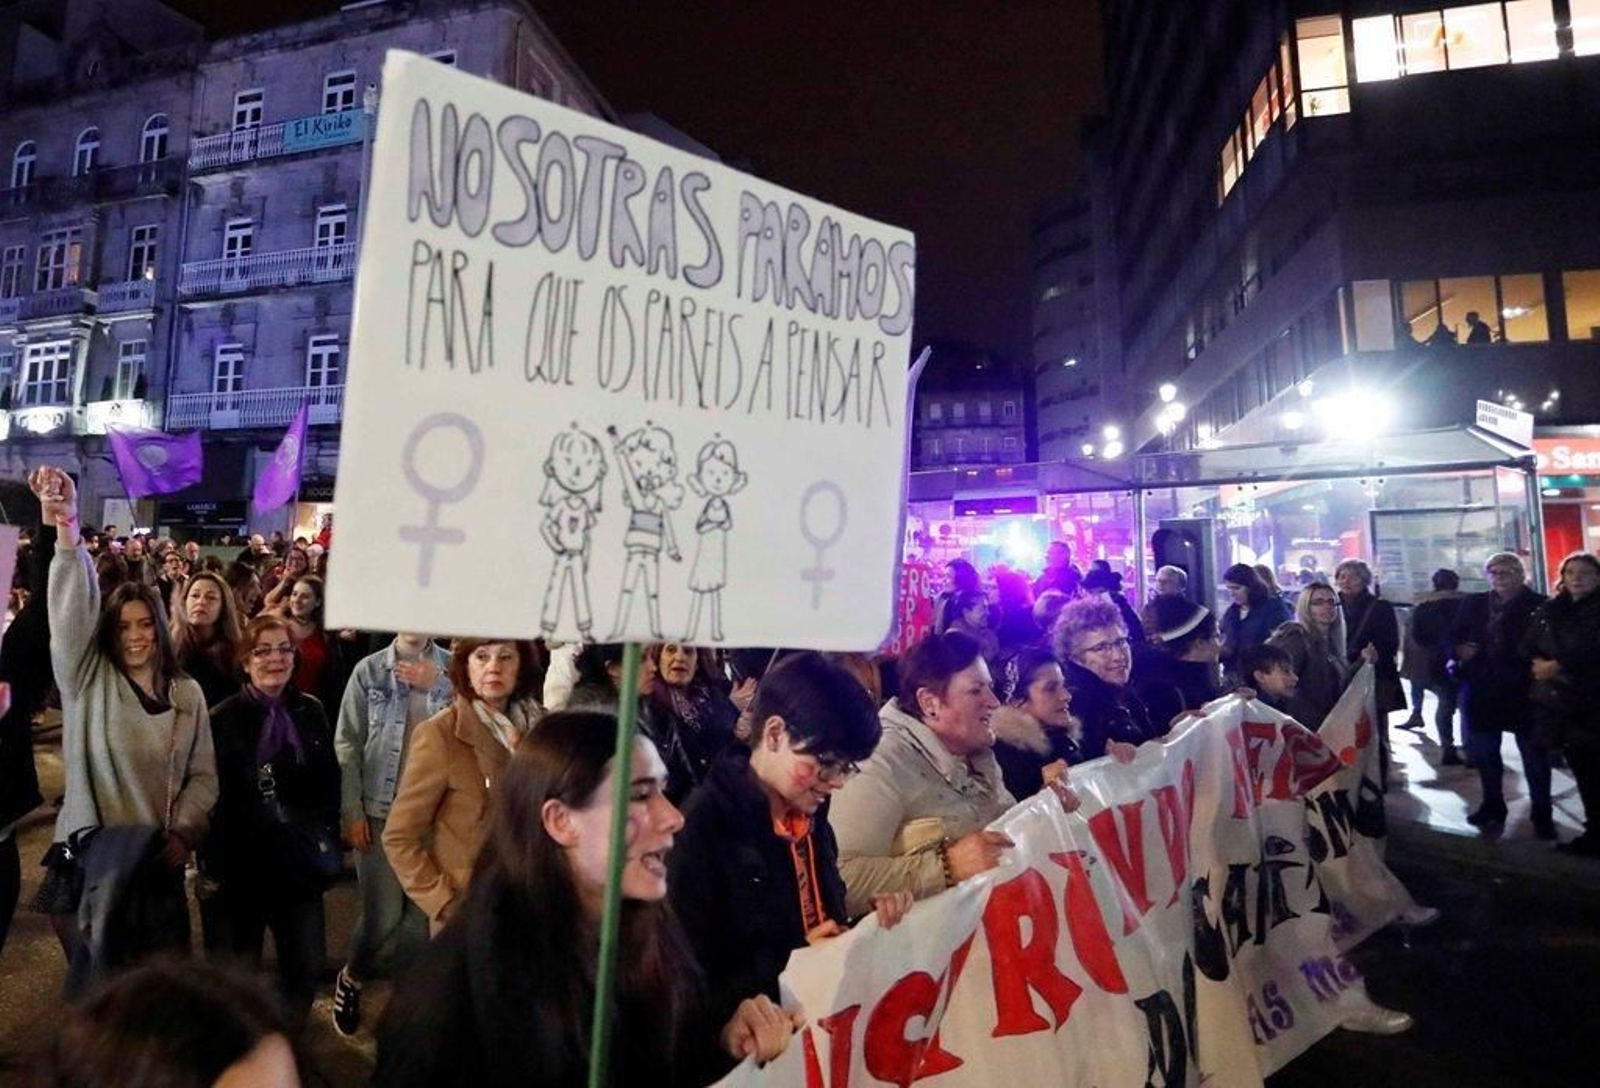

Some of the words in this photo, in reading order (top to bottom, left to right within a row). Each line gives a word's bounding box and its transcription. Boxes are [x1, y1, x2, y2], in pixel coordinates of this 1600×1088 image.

[294, 121, 309, 138] El
[311, 113, 352, 136] Kiriko
[407, 97, 724, 290] NOSOTRAS
[736, 189, 916, 337] PARAMOS
[405, 238, 495, 376] PARA
[524, 270, 585, 386] QUE
[597, 284, 636, 394] OS
[642, 288, 745, 411] PAREIS
[747, 316, 775, 415] A
[786, 319, 892, 429] PENSAR
